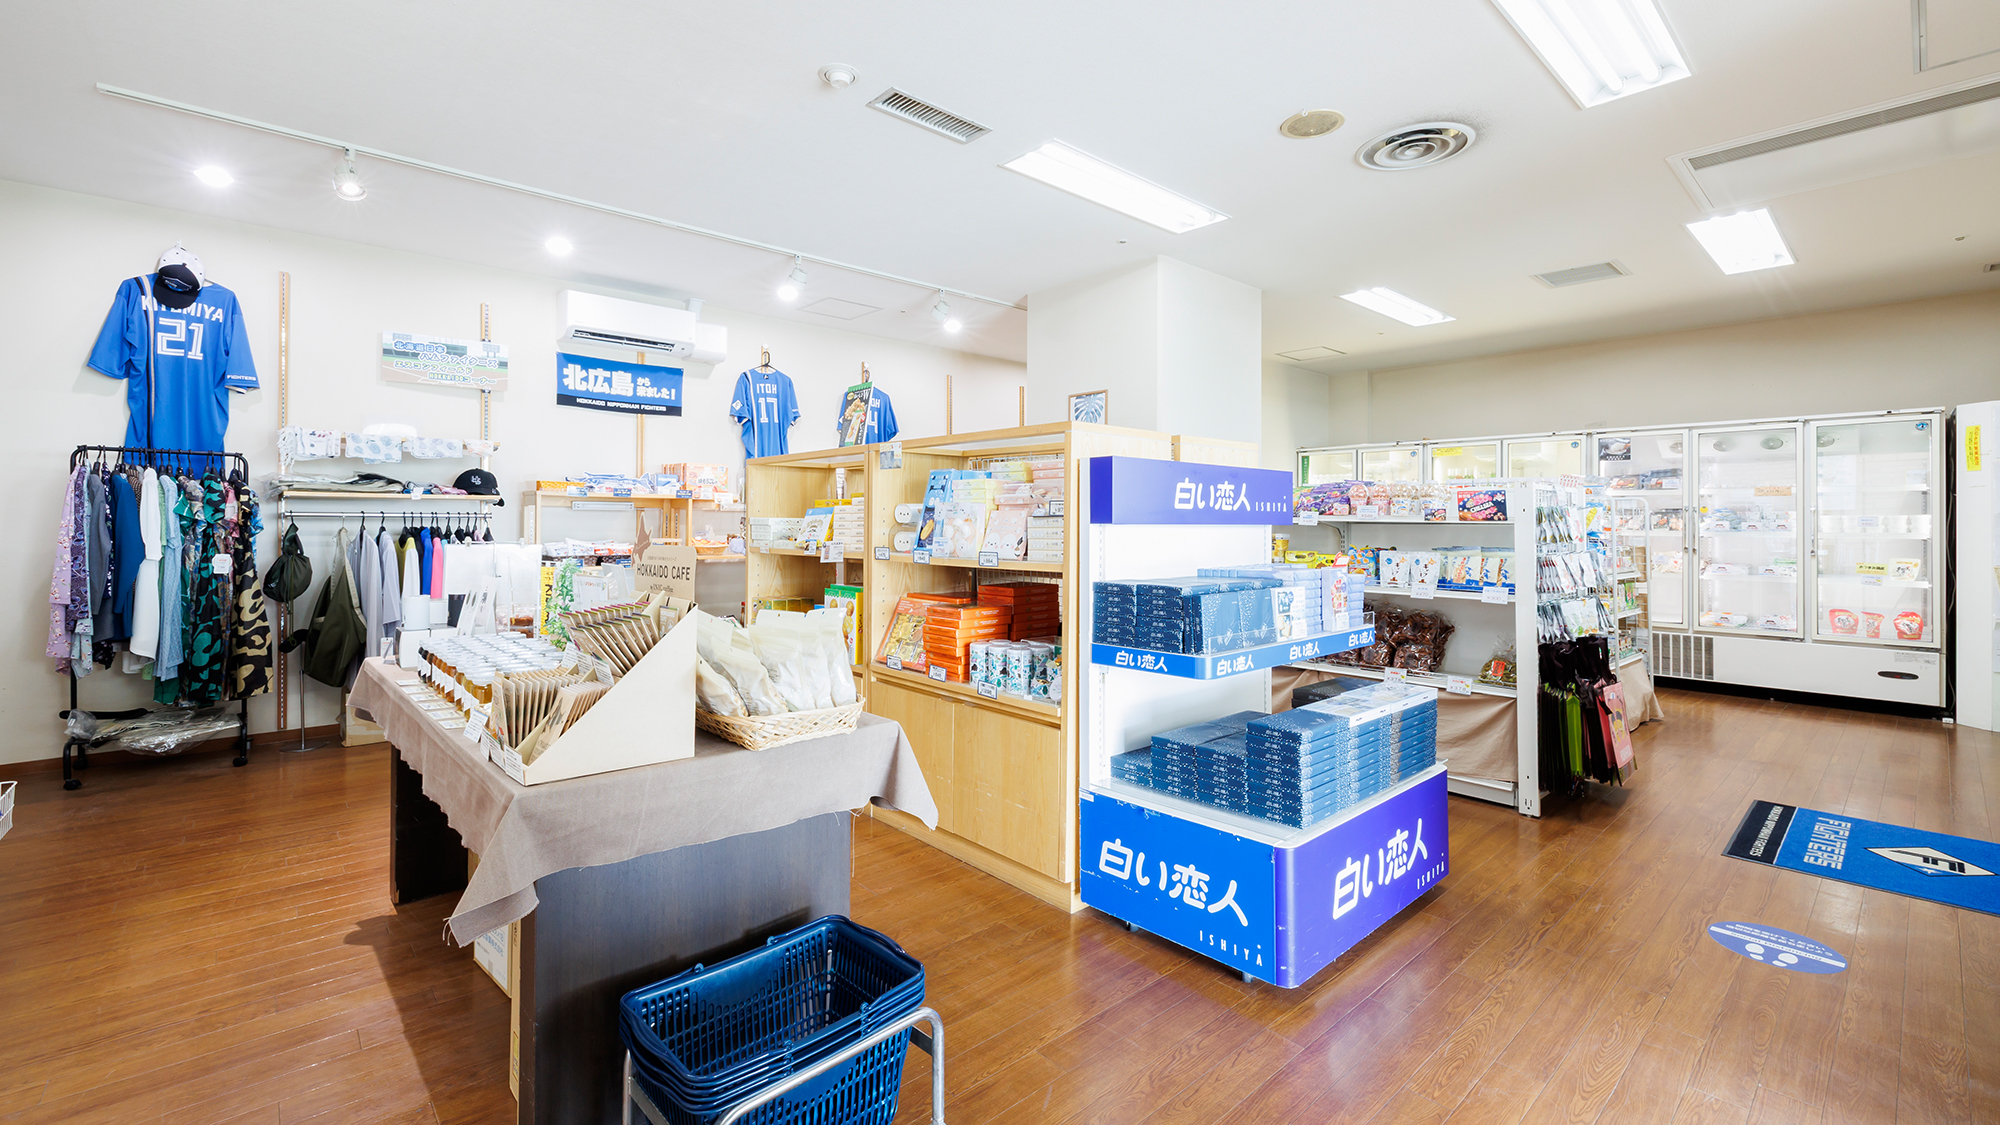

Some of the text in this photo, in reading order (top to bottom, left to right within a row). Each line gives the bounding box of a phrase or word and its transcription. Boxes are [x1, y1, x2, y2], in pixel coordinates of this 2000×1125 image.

[157, 317, 204, 361] 21
[394, 340, 447, 354] 北海道日本
[562, 363, 634, 397] 北広島
[636, 376, 651, 387] から
[756, 383, 777, 395] ITOH
[576, 397, 606, 407] HOKKAIDO
[757, 397, 779, 424] 17
[1174, 477, 1288, 513] 白い恋人 ISHIYA
[637, 563, 691, 581] HOKKAIDO CAFE
[1289, 640, 1321, 661] 白い恋人
[1348, 629, 1374, 648] 白い恋人
[1115, 650, 1168, 673] 白い恋人
[1216, 654, 1255, 676] 白い恋人
[1803, 817, 1852, 870] FIGHTERS
[1332, 818, 1428, 921] 白い恋人
[1416, 852, 1446, 890] ISHIYA
[1099, 838, 1249, 927] 白い恋人
[1199, 930, 1264, 967] ISHIYA
